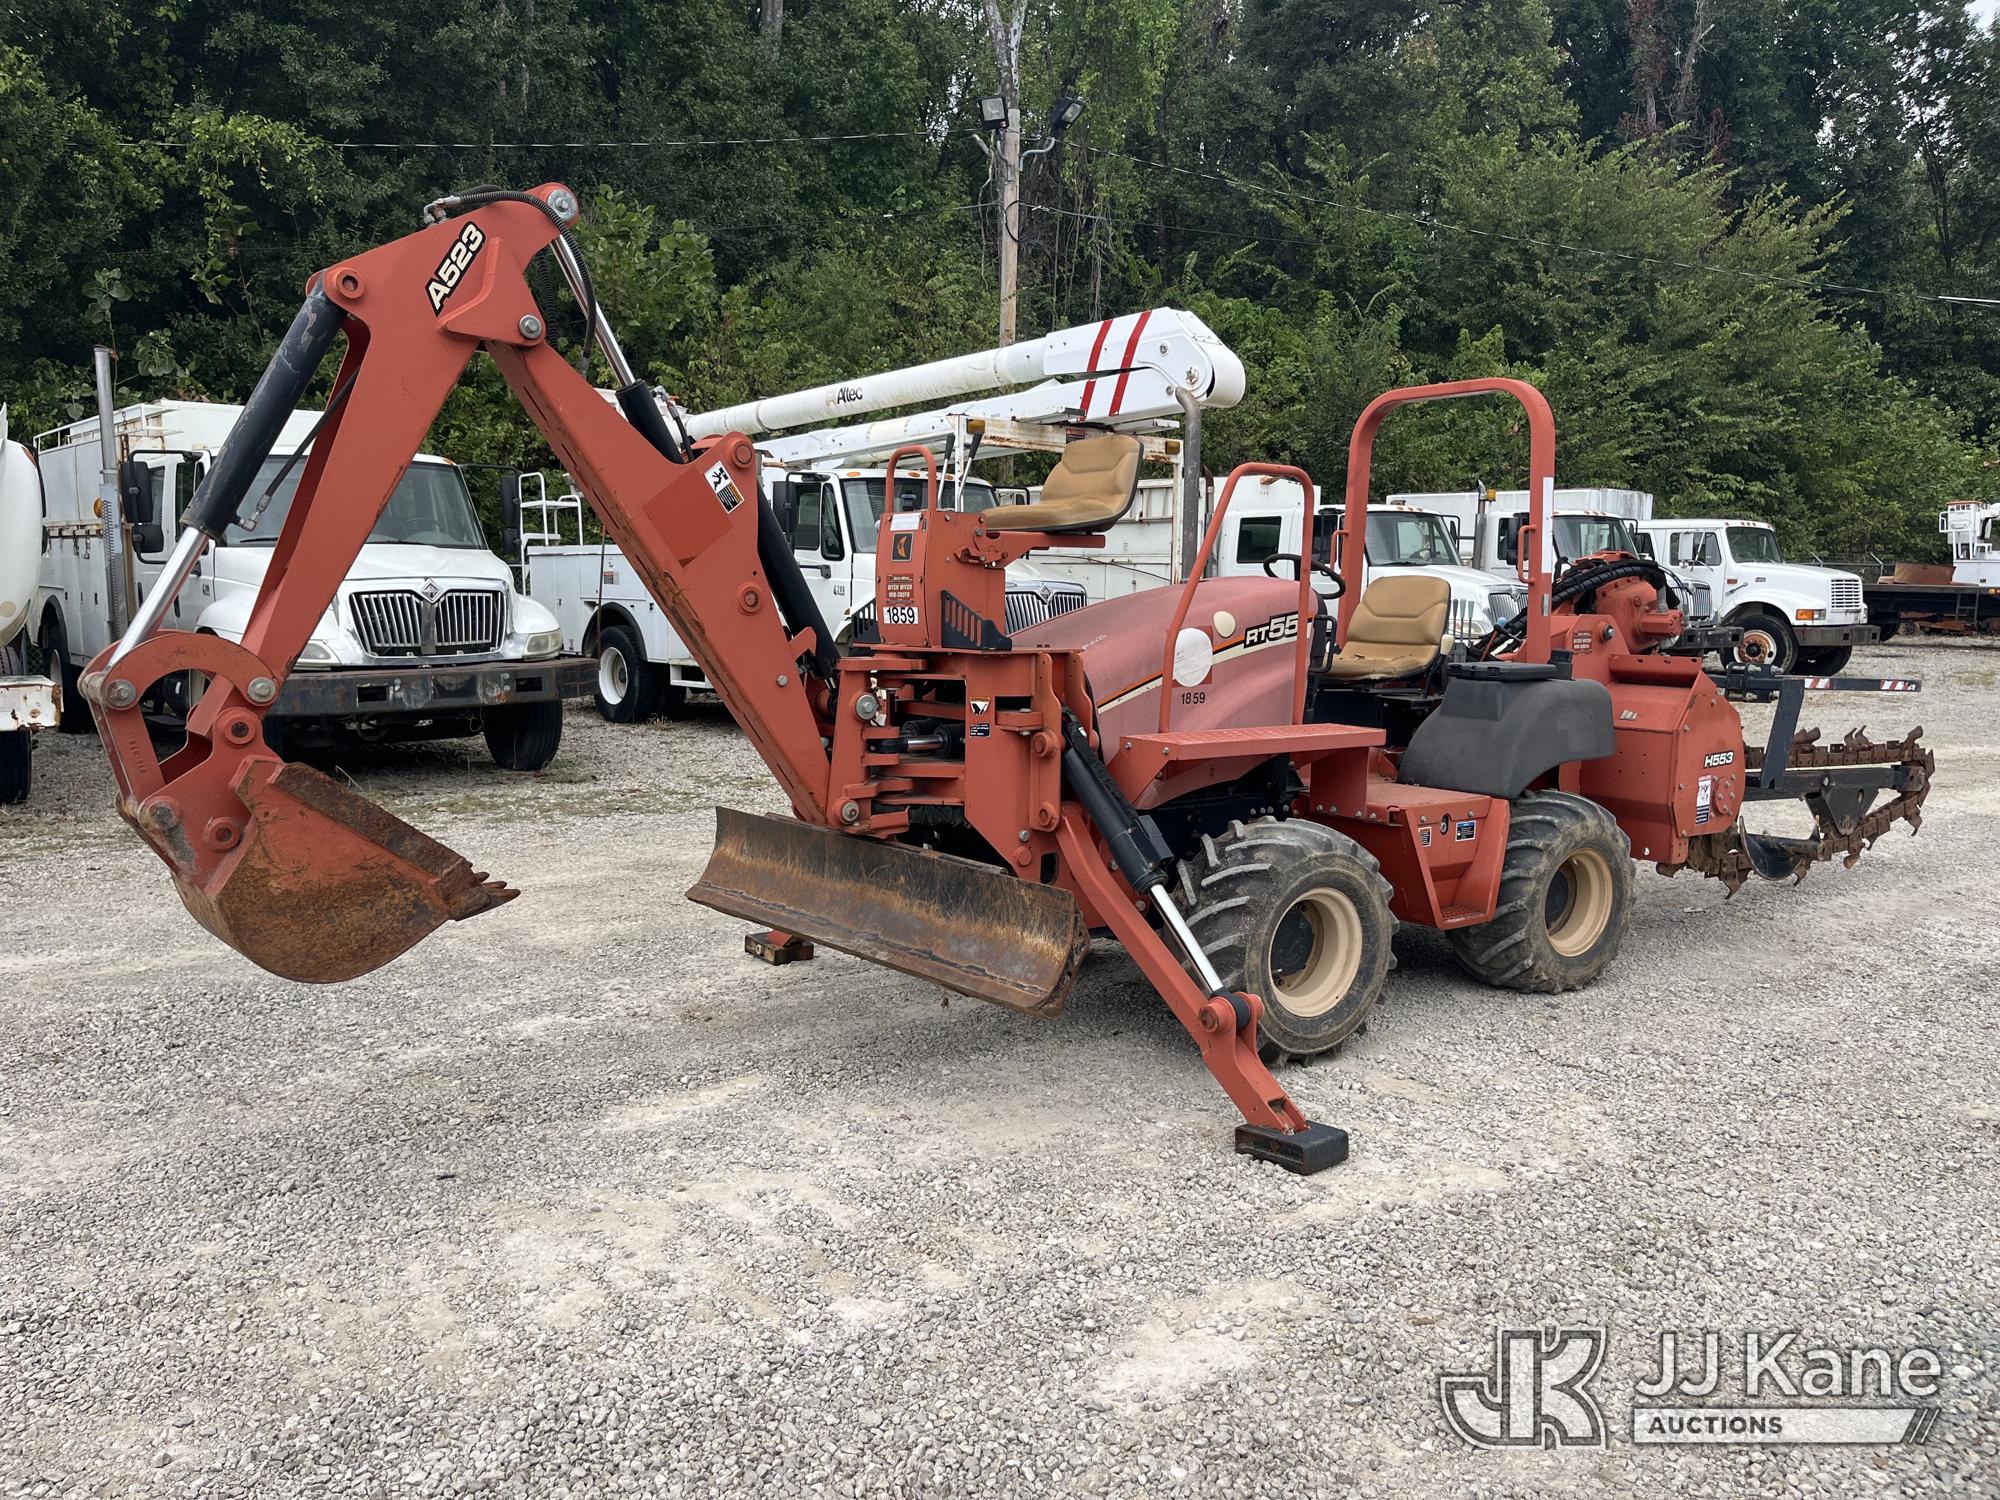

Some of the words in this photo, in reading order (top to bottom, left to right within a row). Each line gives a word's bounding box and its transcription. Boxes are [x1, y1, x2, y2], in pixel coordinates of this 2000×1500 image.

[426, 222, 484, 312] A523
[837, 387, 863, 405] Altec
[886, 606, 915, 624] 1859
[1244, 612, 1298, 646] RT55
[1181, 691, 1206, 705] 1859
[1703, 751, 1734, 768] H553
